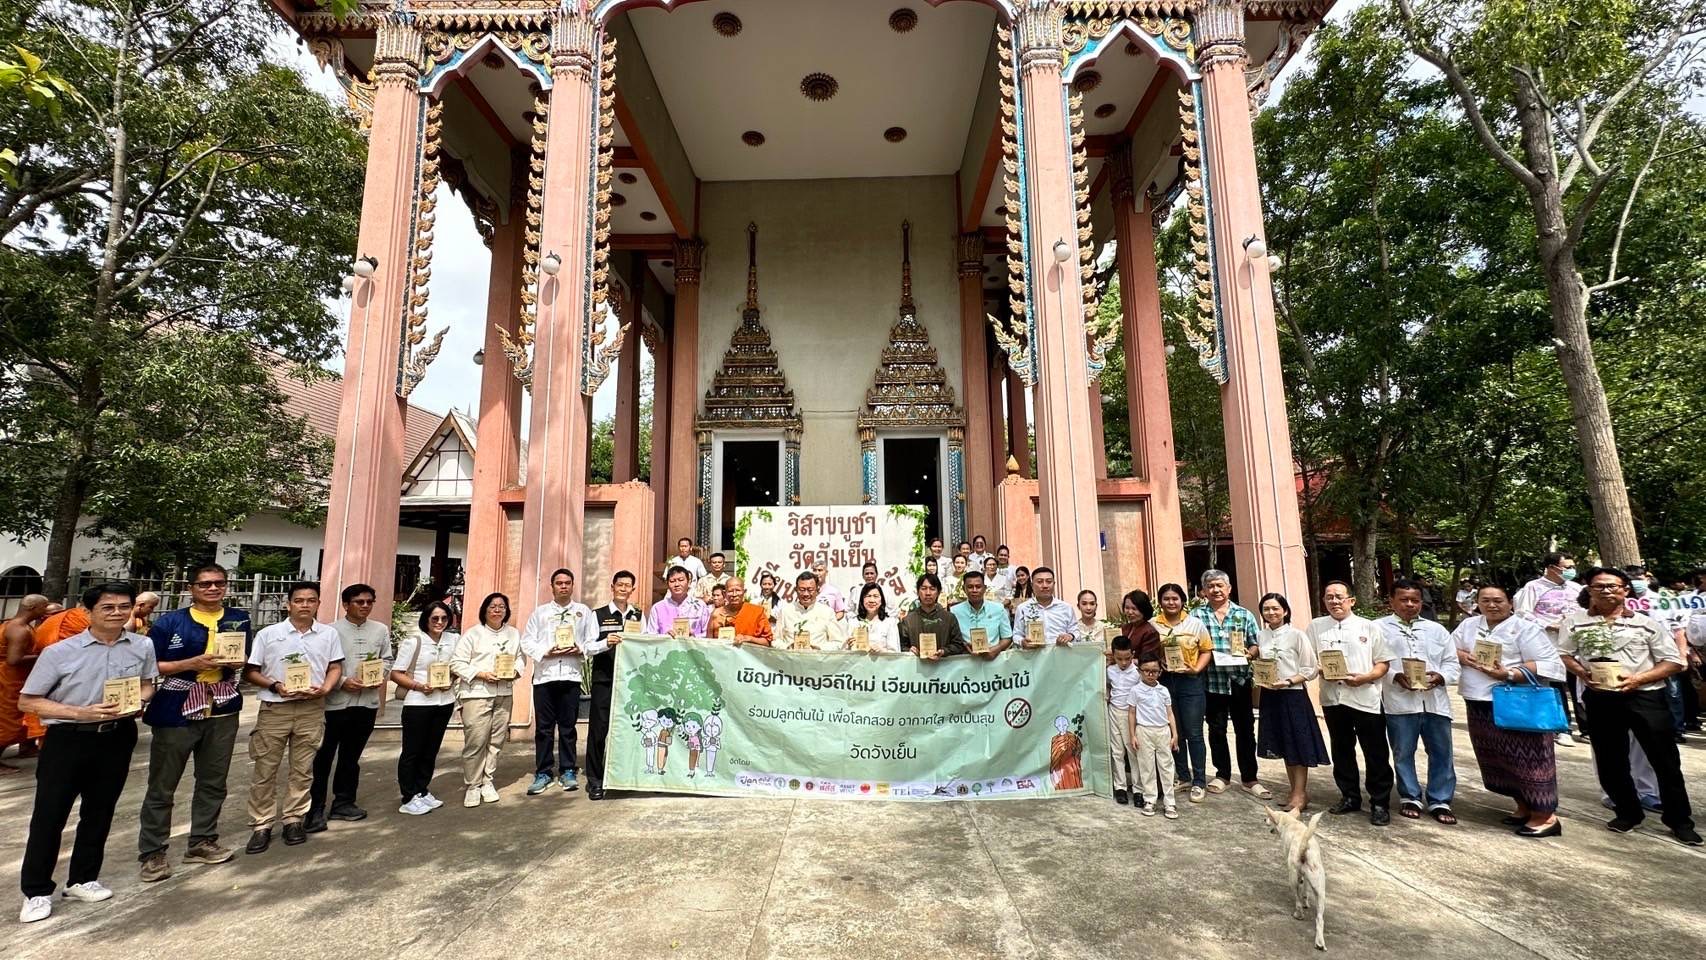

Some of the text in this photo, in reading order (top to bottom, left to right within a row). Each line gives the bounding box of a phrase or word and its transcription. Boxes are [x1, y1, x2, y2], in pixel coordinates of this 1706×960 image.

[787, 511, 876, 542] วิสาขบูชา
[789, 540, 877, 570] วัดวังเย็น
[736, 667, 1030, 695] เชิญทำบุญวิถีใหม่ เวียนเทียนด้วยต้นไม้
[748, 704, 995, 728] ร่วมปลูกต้นไม้ เพื่อโลกสวย อากาศใส ใจเป็นสุข
[849, 741, 917, 760] วัดวังเย็น
